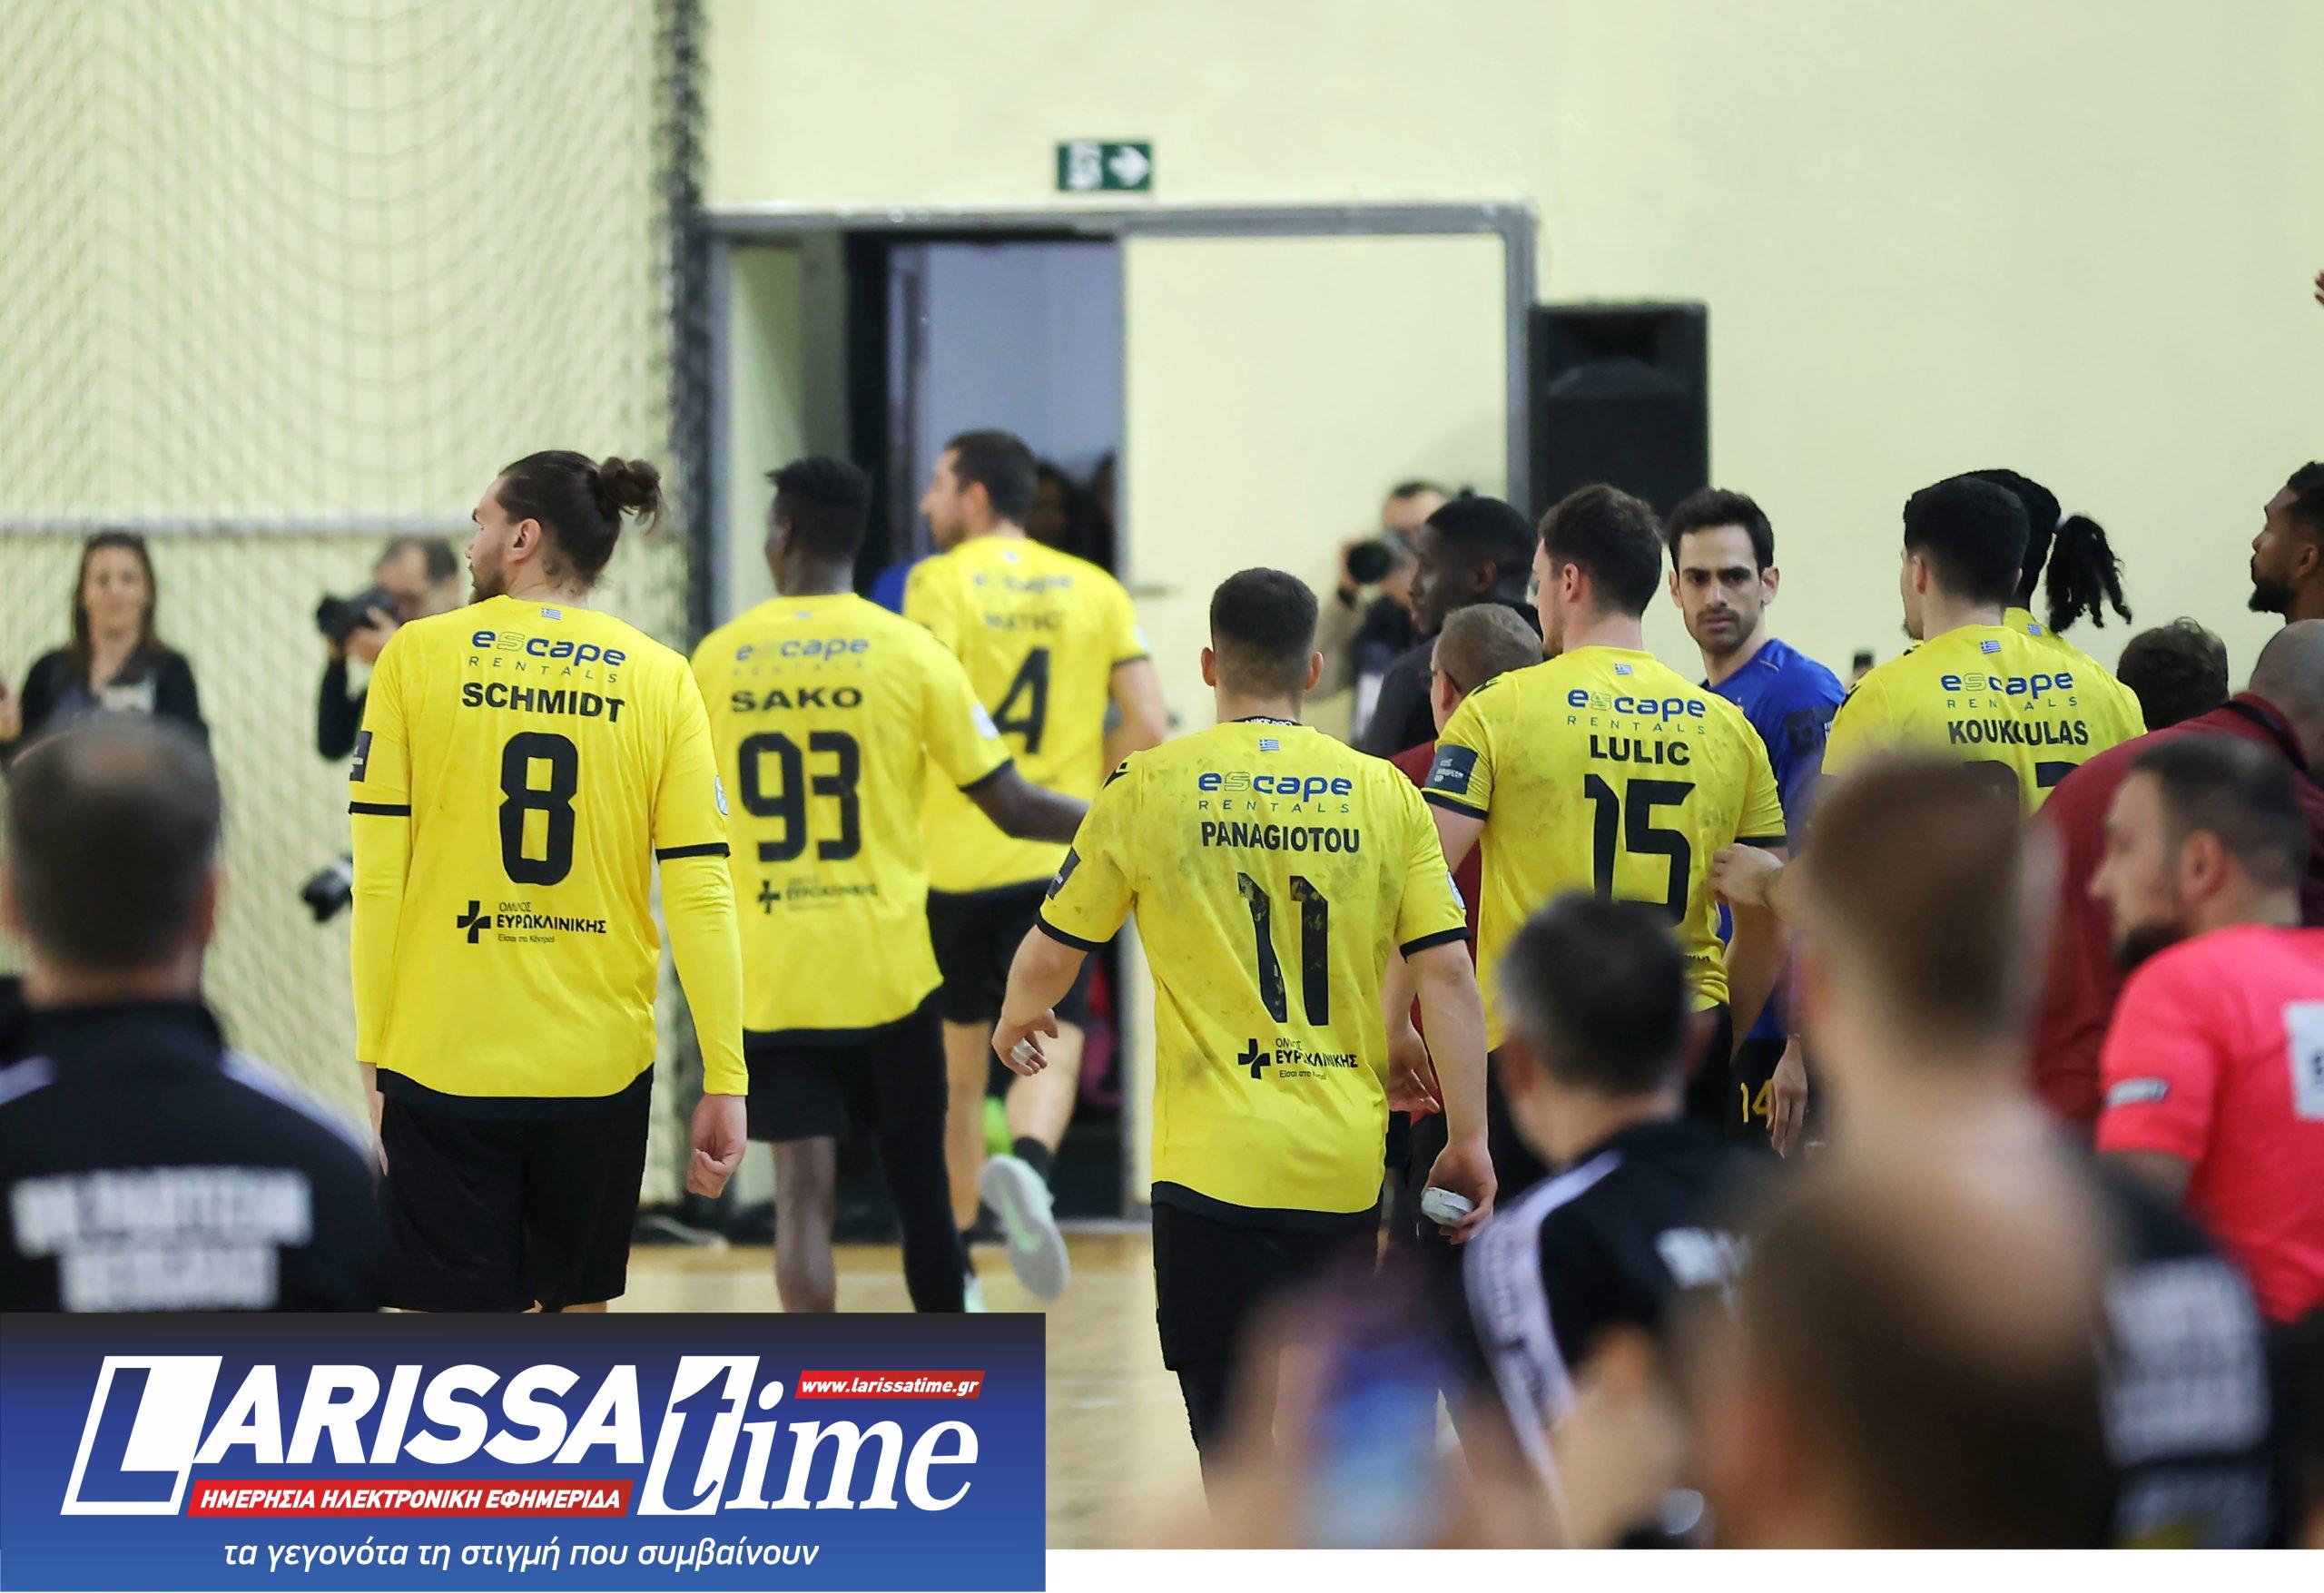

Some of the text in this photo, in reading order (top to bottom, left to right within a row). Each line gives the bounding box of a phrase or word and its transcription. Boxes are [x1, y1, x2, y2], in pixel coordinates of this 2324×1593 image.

[472, 630, 626, 666] escape
[468, 655, 618, 683] RENTALS
[731, 686, 863, 713] SAKO
[992, 646, 1050, 755] 4
[1940, 672, 2074, 700] escape
[462, 682, 625, 723] SCHMIDT
[1568, 689, 1707, 723] escape
[1947, 696, 2078, 711] RENALS
[1567, 715, 1706, 735] RENTALS
[1590, 734, 1690, 766] LULIC
[738, 731, 861, 862] 93
[1198, 772, 1353, 802] escape
[499, 732, 578, 886] 8
[1198, 800, 1350, 813] RENTALS
[1201, 821, 1360, 853] PANAGIOTOU
[1584, 773, 1696, 927] 15
[497, 914, 607, 934] ΕΥΡΩΚΛΙΝΙΚΗΣ
[1237, 872, 1329, 1026] 11
[1275, 1049, 1359, 1068] ΕΥΡΚΛΙΝΙΚΗΣ
[1740, 1078, 1773, 1124] 14
